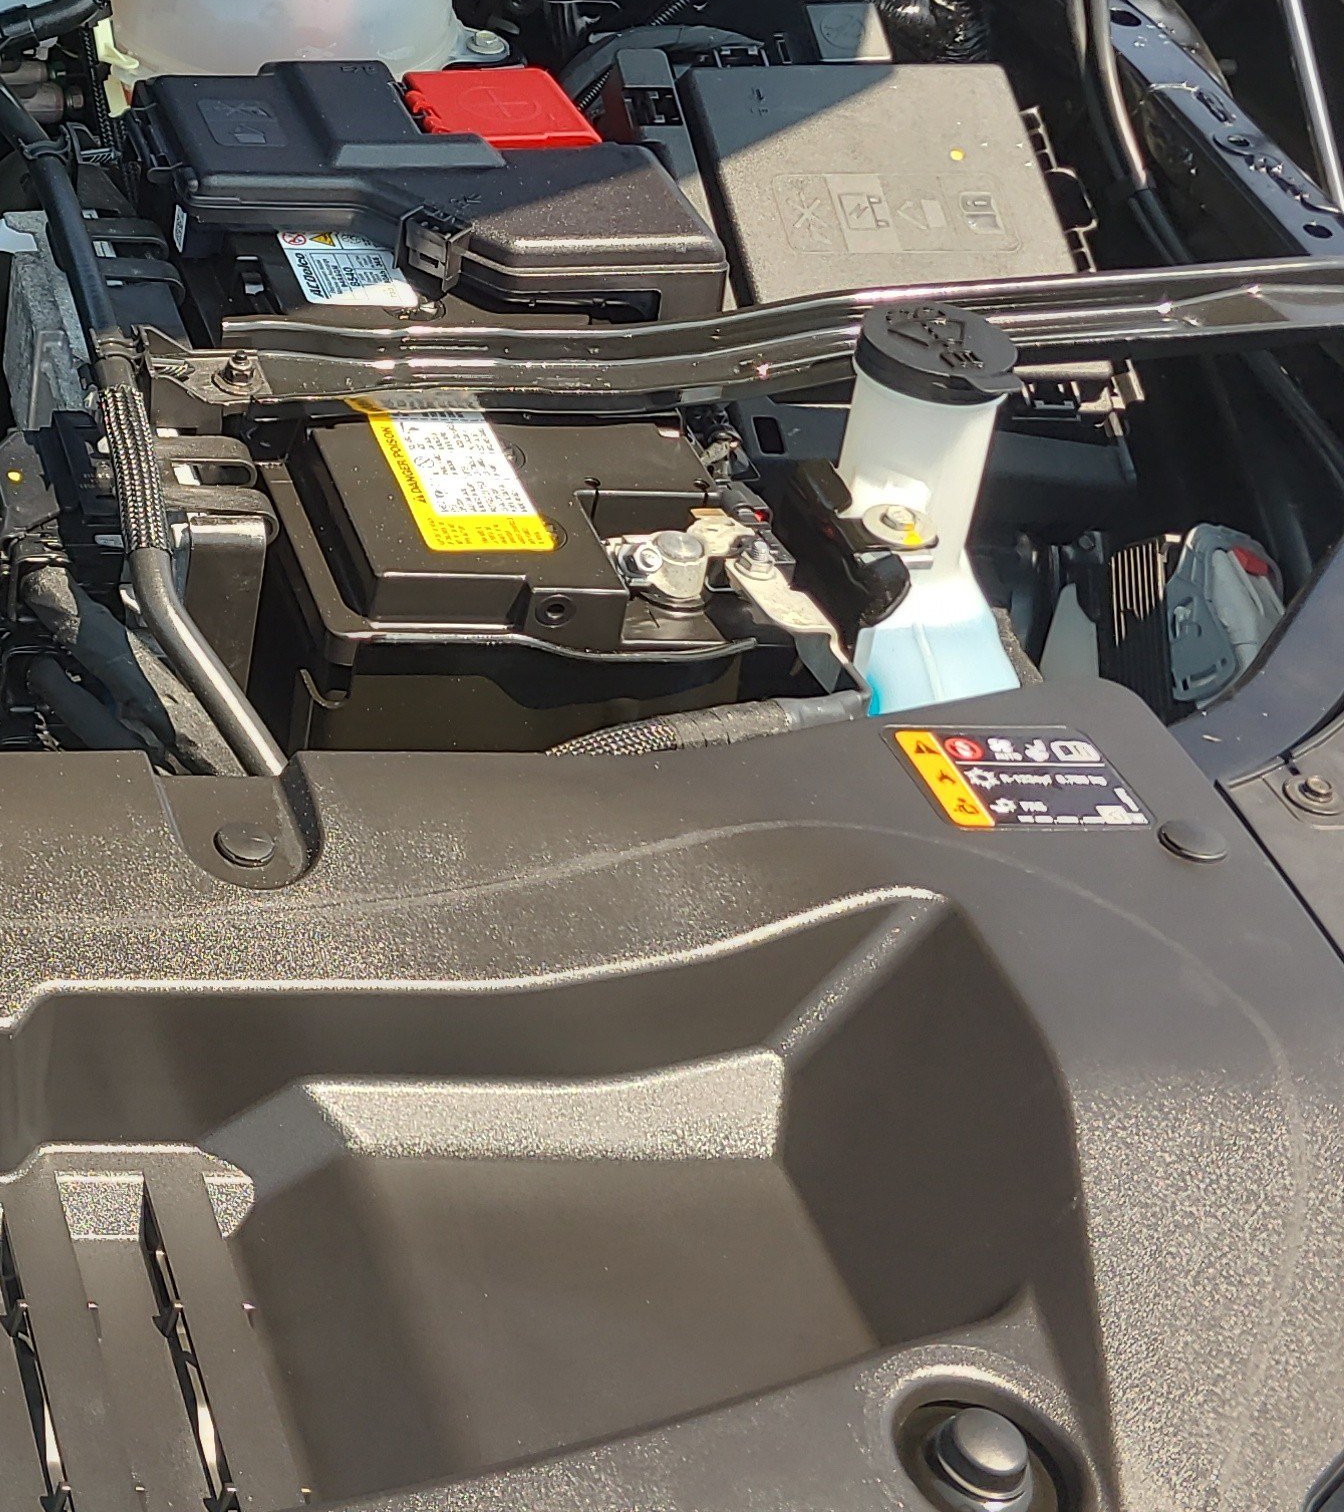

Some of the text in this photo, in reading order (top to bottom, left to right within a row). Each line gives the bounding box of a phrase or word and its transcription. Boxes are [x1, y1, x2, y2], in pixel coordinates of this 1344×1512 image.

[294, 251, 324, 299] ACDelco
[381, 425, 422, 499] DANGER POISON
